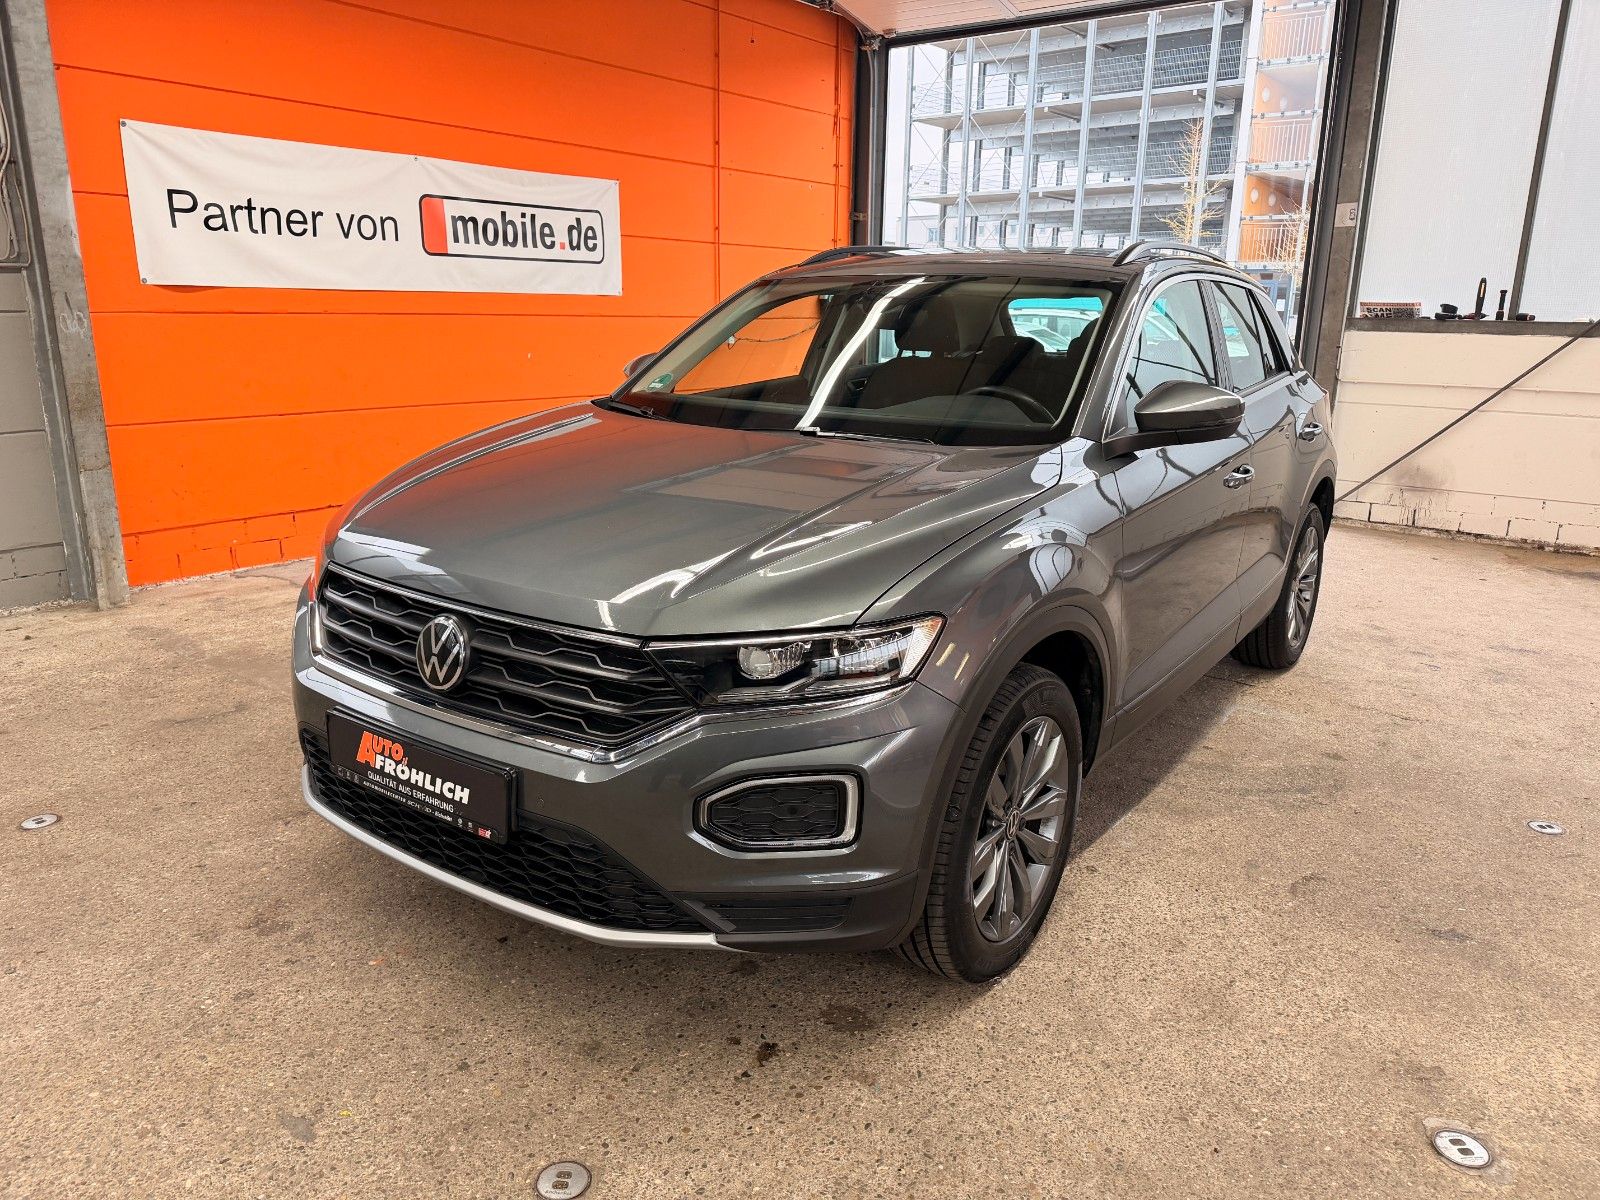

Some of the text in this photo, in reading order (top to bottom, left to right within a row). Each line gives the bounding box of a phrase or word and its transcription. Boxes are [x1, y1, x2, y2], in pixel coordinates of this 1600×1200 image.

[165, 187, 599, 253] Partner von mobile.de
[355, 730, 405, 768] AUTO
[367, 770, 397, 789] QUALITÄT
[398, 783, 412, 796] AUS
[412, 790, 455, 813] ERFAHRUNG
[375, 757, 471, 805] FRÖHLICH
